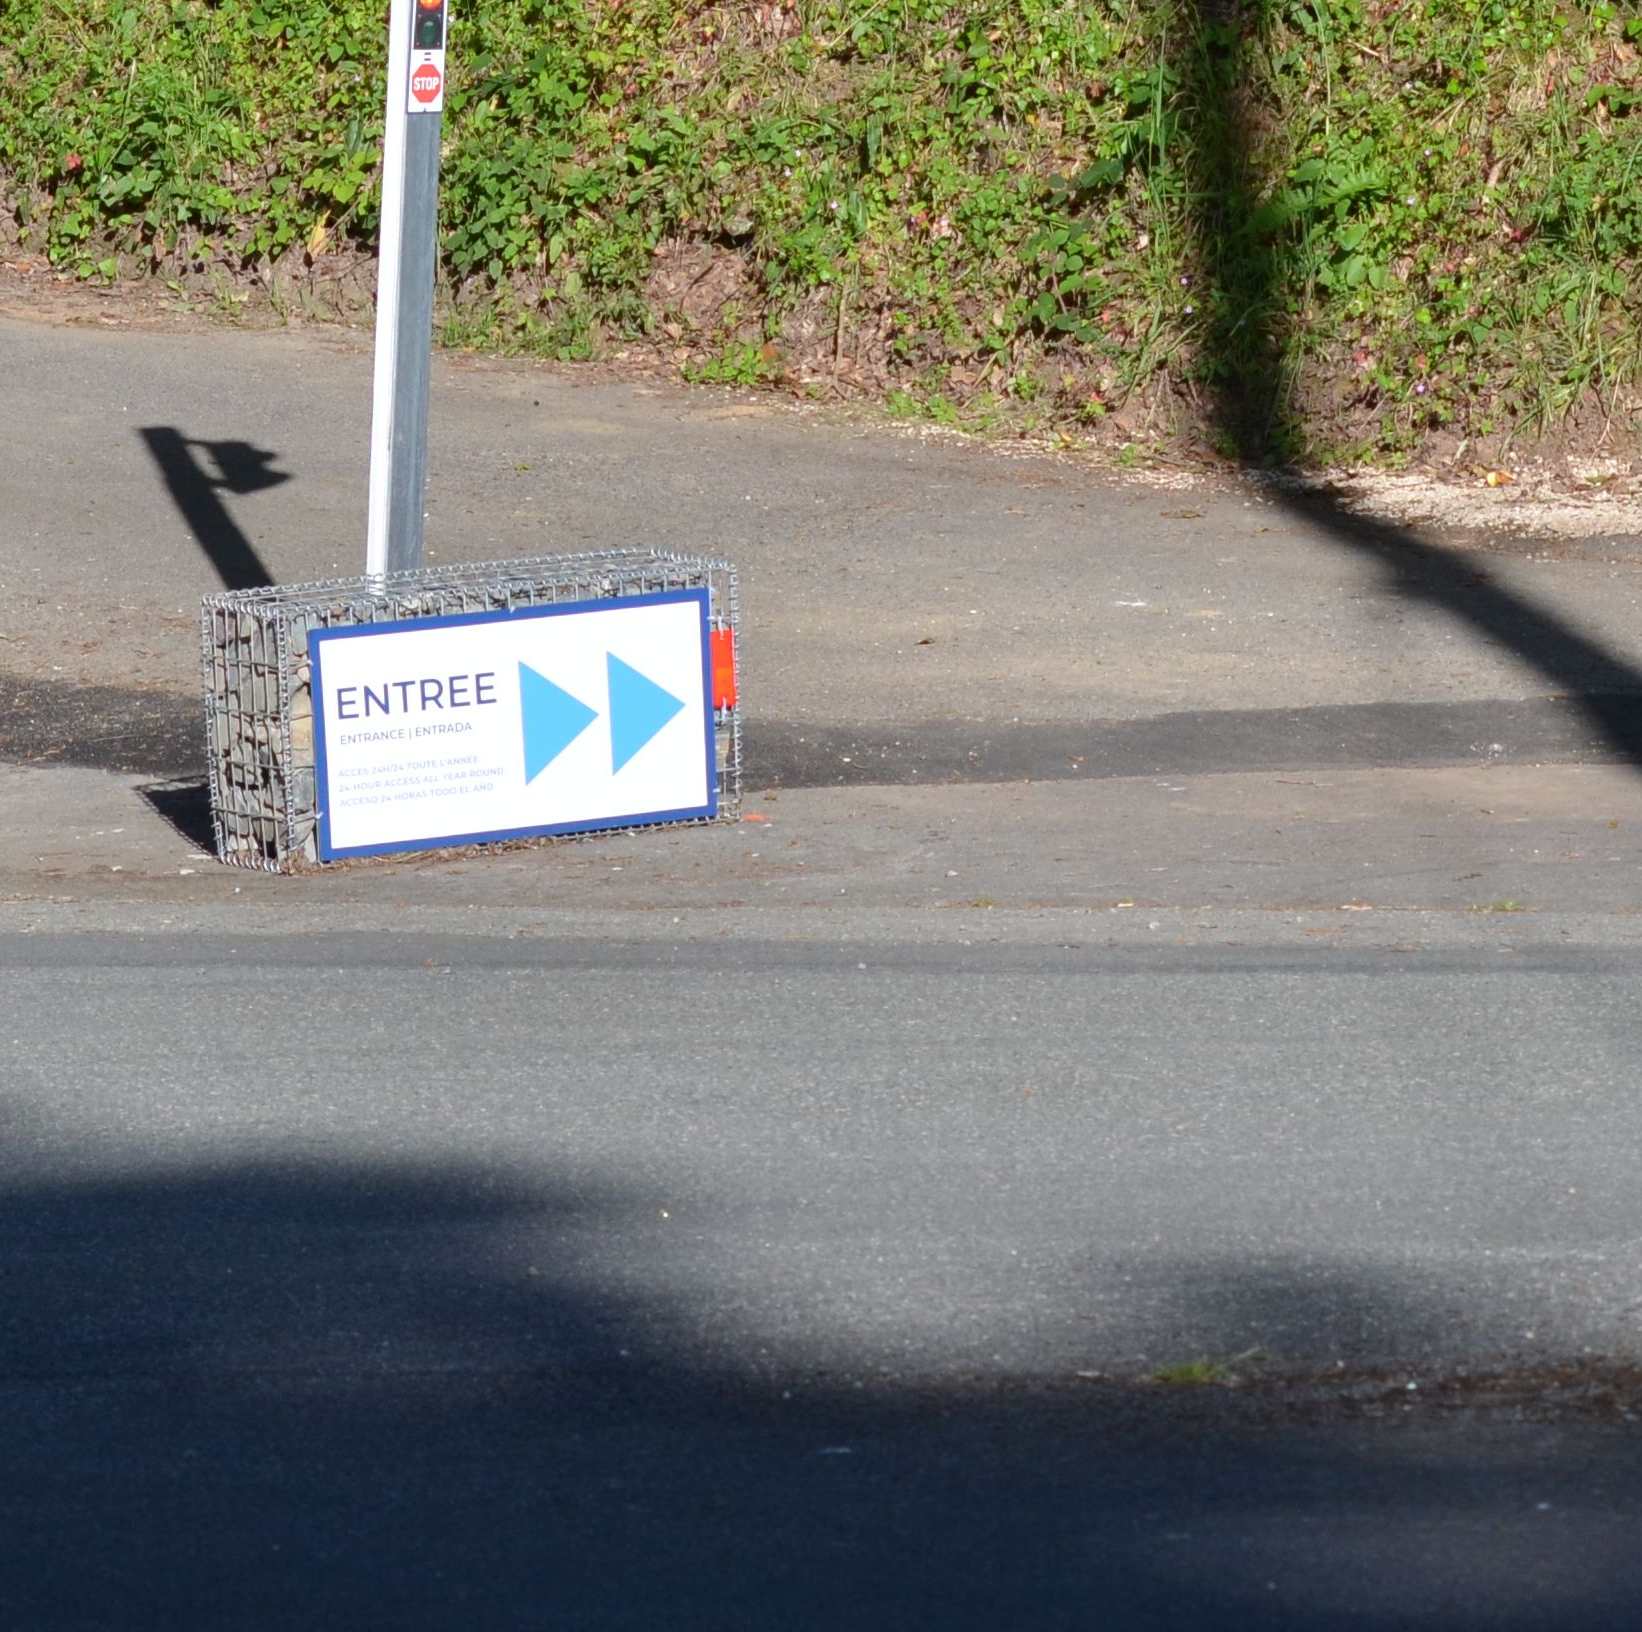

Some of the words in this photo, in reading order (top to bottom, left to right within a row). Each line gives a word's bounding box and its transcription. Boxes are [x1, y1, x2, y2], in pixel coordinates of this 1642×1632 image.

[414, 77, 439, 90] STOP
[336, 672, 497, 720] ENTREE
[340, 728, 405, 745] ENTRANCE
[415, 721, 473, 739] ENTRADA
[338, 768, 369, 776] ACCES
[371, 764, 404, 774] 24H/24
[407, 760, 437, 770] TOUTE
[384, 777, 420, 786] ACCESS
[443, 771, 467, 780] YEAR
[470, 767, 504, 777] ROUND
[339, 796, 377, 806] ACCESO
[395, 791, 427, 800] HORAS
[431, 787, 456, 796] TODO
[473, 782, 493, 791] AÑO
